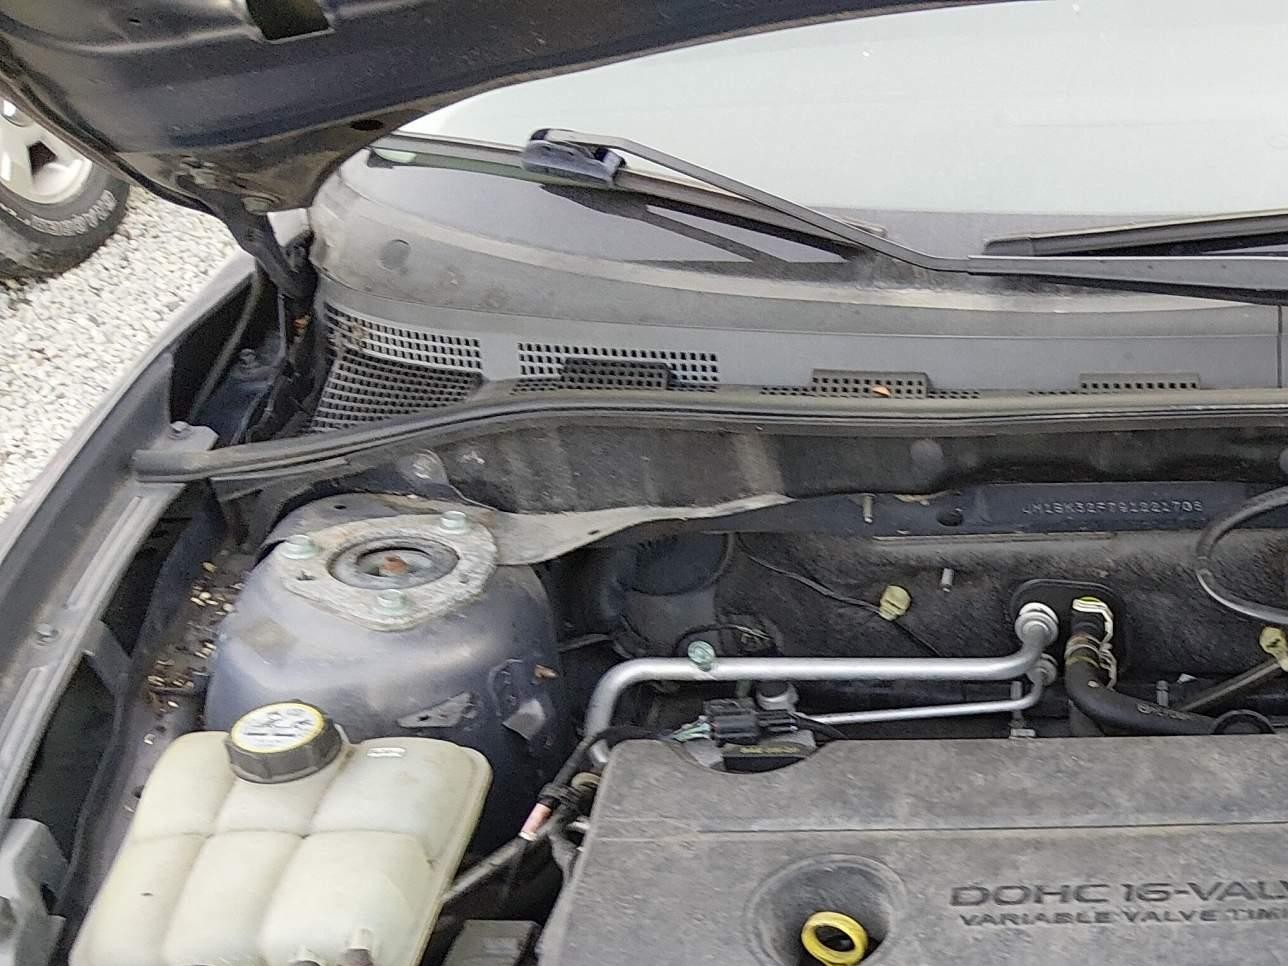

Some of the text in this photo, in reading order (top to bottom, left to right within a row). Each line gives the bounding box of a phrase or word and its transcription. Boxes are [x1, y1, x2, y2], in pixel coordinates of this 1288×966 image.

[951, 883, 1110, 906] DOHC
[960, 911, 1113, 926] VARIABLE
[1122, 909, 1217, 923] VALVE
